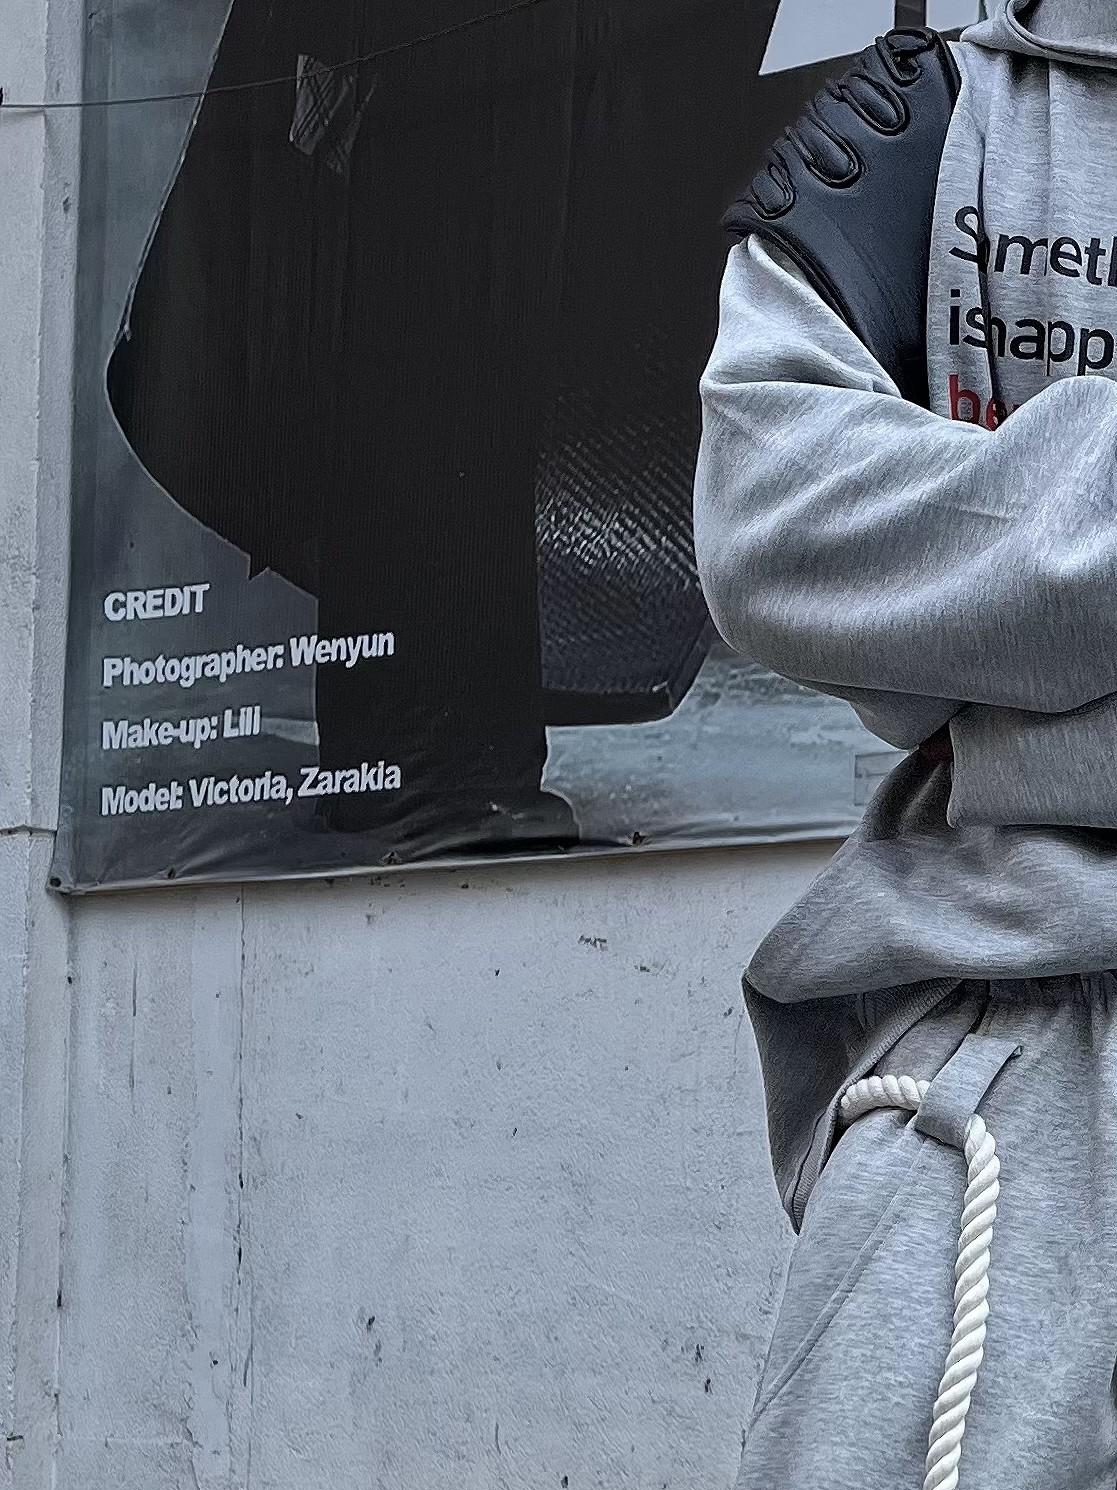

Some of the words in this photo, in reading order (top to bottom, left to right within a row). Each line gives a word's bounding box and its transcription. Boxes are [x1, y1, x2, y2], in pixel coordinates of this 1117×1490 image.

[103, 583, 210, 622] CREDIT
[102, 643, 284, 689] Photographer:
[289, 631, 395, 669] Wenyun
[102, 715, 218, 750] Make-up:
[101, 780, 183, 817] Model:
[188, 770, 293, 806] Victoria,
[297, 760, 401, 797] Zarakia
